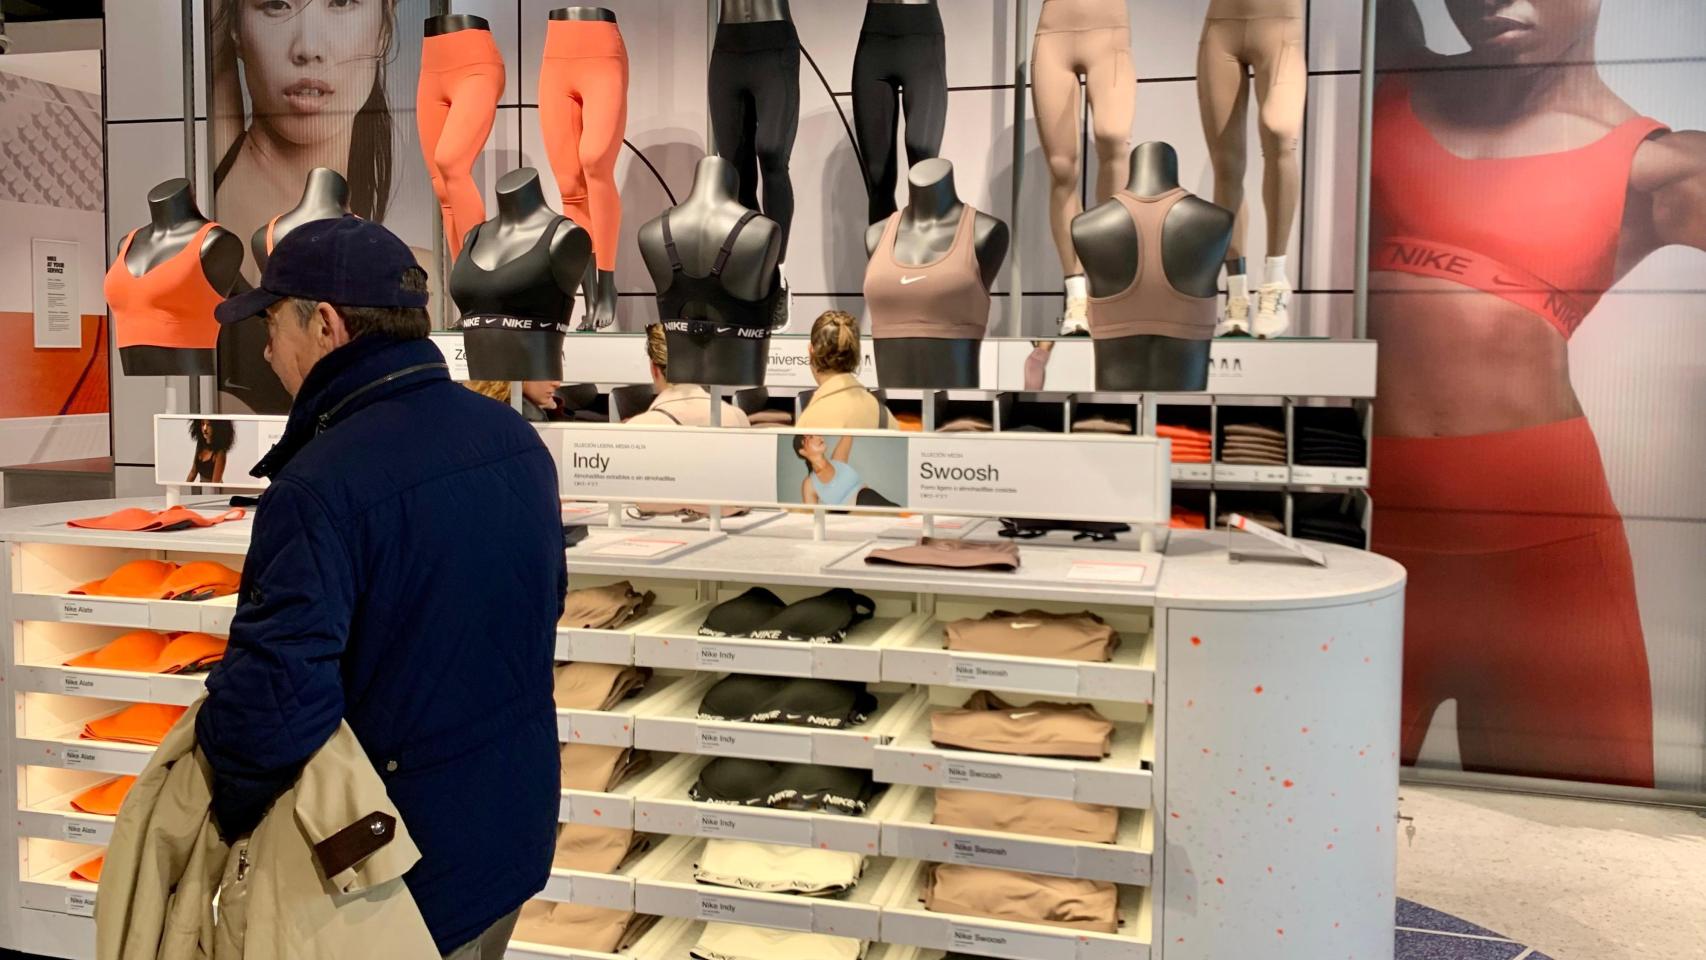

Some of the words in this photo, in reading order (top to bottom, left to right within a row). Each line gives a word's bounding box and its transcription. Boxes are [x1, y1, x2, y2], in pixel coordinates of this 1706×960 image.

[1390, 246, 1472, 276] NIKE
[1543, 293, 1586, 328] NIK
[463, 317, 480, 328] NIKE
[502, 317, 532, 328] NIKE
[665, 321, 689, 332] NIKE
[737, 327, 765, 338] NIKE
[573, 452, 610, 473] Indy
[920, 462, 999, 481] Swoosh
[751, 630, 782, 640] NIKE
[701, 650, 718, 658] Nike
[719, 651, 735, 661] Indy
[955, 665, 973, 674] Nike
[976, 667, 1008, 677] Swoosh
[65, 678, 78, 686] Nike
[751, 710, 781, 722] NIKE
[807, 714, 842, 727] NIKE
[701, 733, 718, 742] Nike
[719, 735, 736, 744] Indy
[948, 767, 966, 776] Nike
[969, 769, 1002, 780] Swoosh
[702, 817, 718, 826] Nike
[719, 819, 736, 828] Indy
[953, 843, 972, 852] Nike
[974, 845, 1007, 856] Swoosh
[702, 900, 718, 909] Nike
[719, 902, 736, 913] Indy
[954, 931, 972, 940] Nike
[974, 934, 1007, 944] Swoosh
